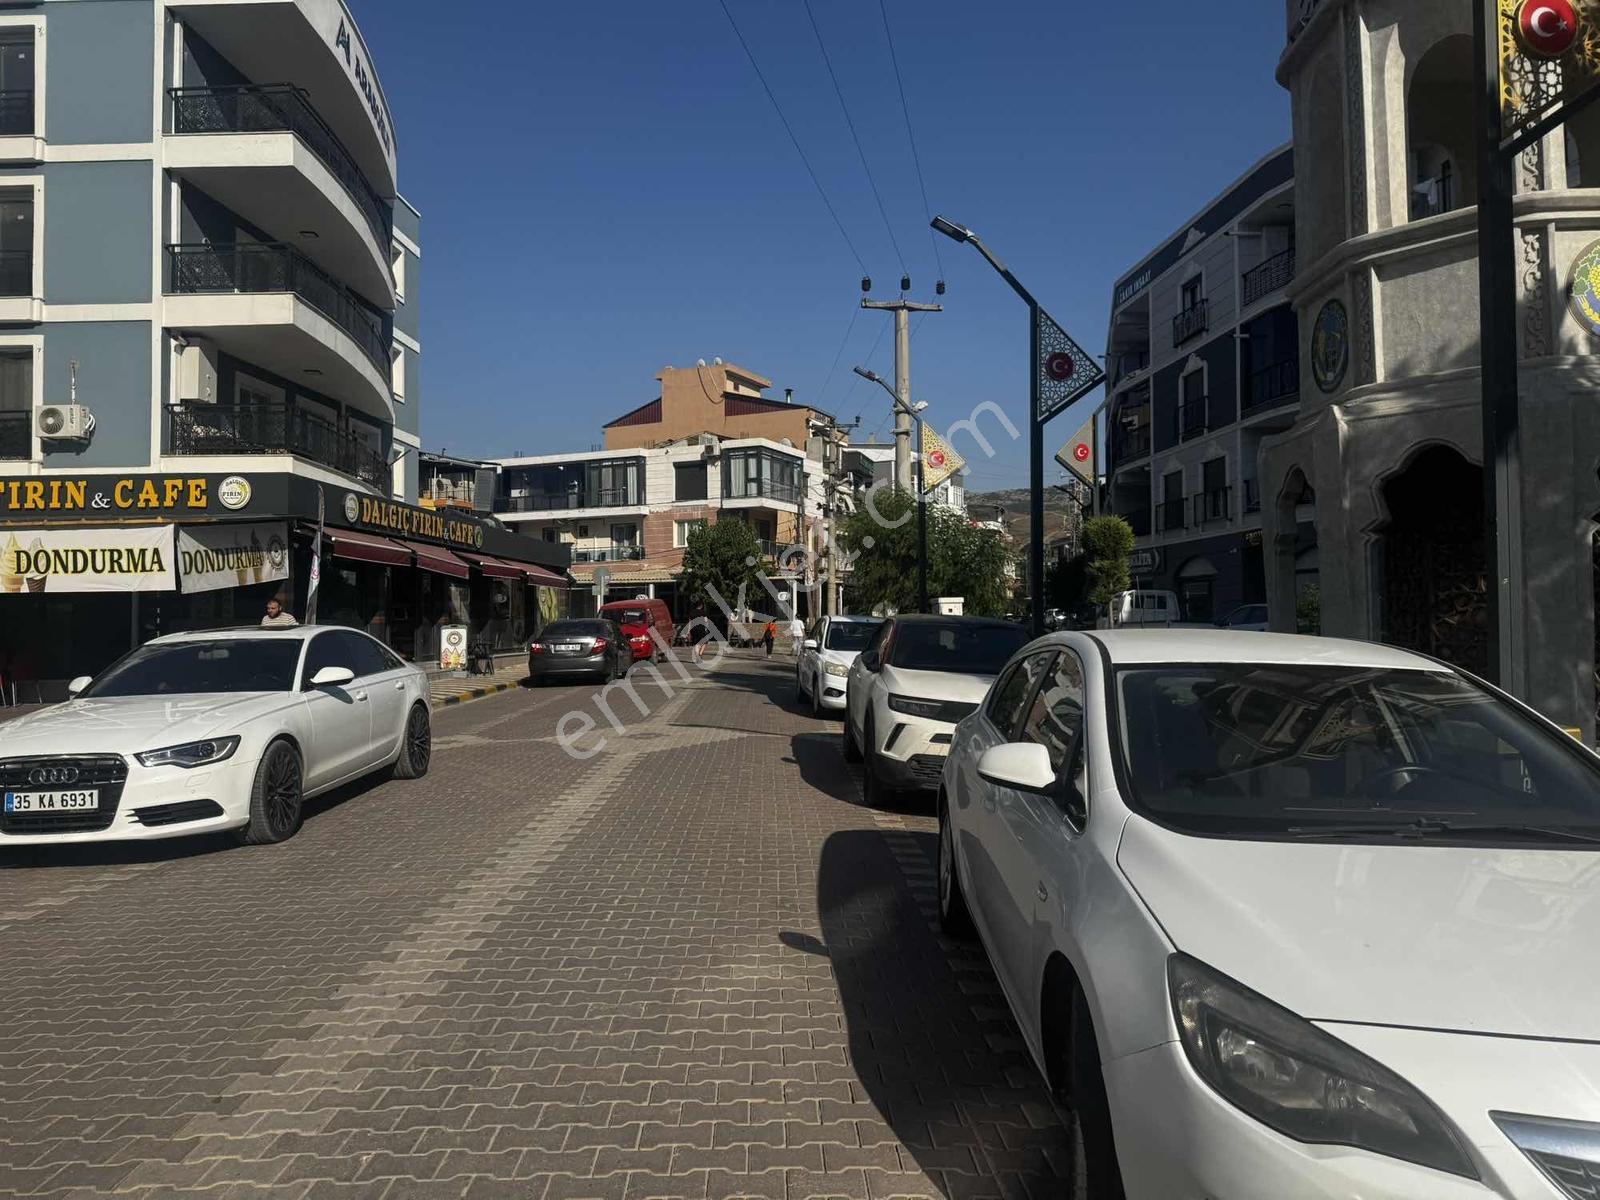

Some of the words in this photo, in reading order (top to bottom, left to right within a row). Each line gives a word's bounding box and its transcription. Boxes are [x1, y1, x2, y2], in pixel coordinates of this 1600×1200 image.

[0, 480, 87, 509] IRIN
[91, 492, 111, 509] &
[114, 478, 208, 508] CAFE
[412, 511, 444, 538] FIRIN
[449, 520, 474, 544] CAFE
[14, 547, 166, 575] DONDURMA
[182, 546, 264, 575] DONDURMA
[14, 795, 31, 810] 35
[39, 794, 55, 809] KA
[60, 792, 94, 808] 6931
